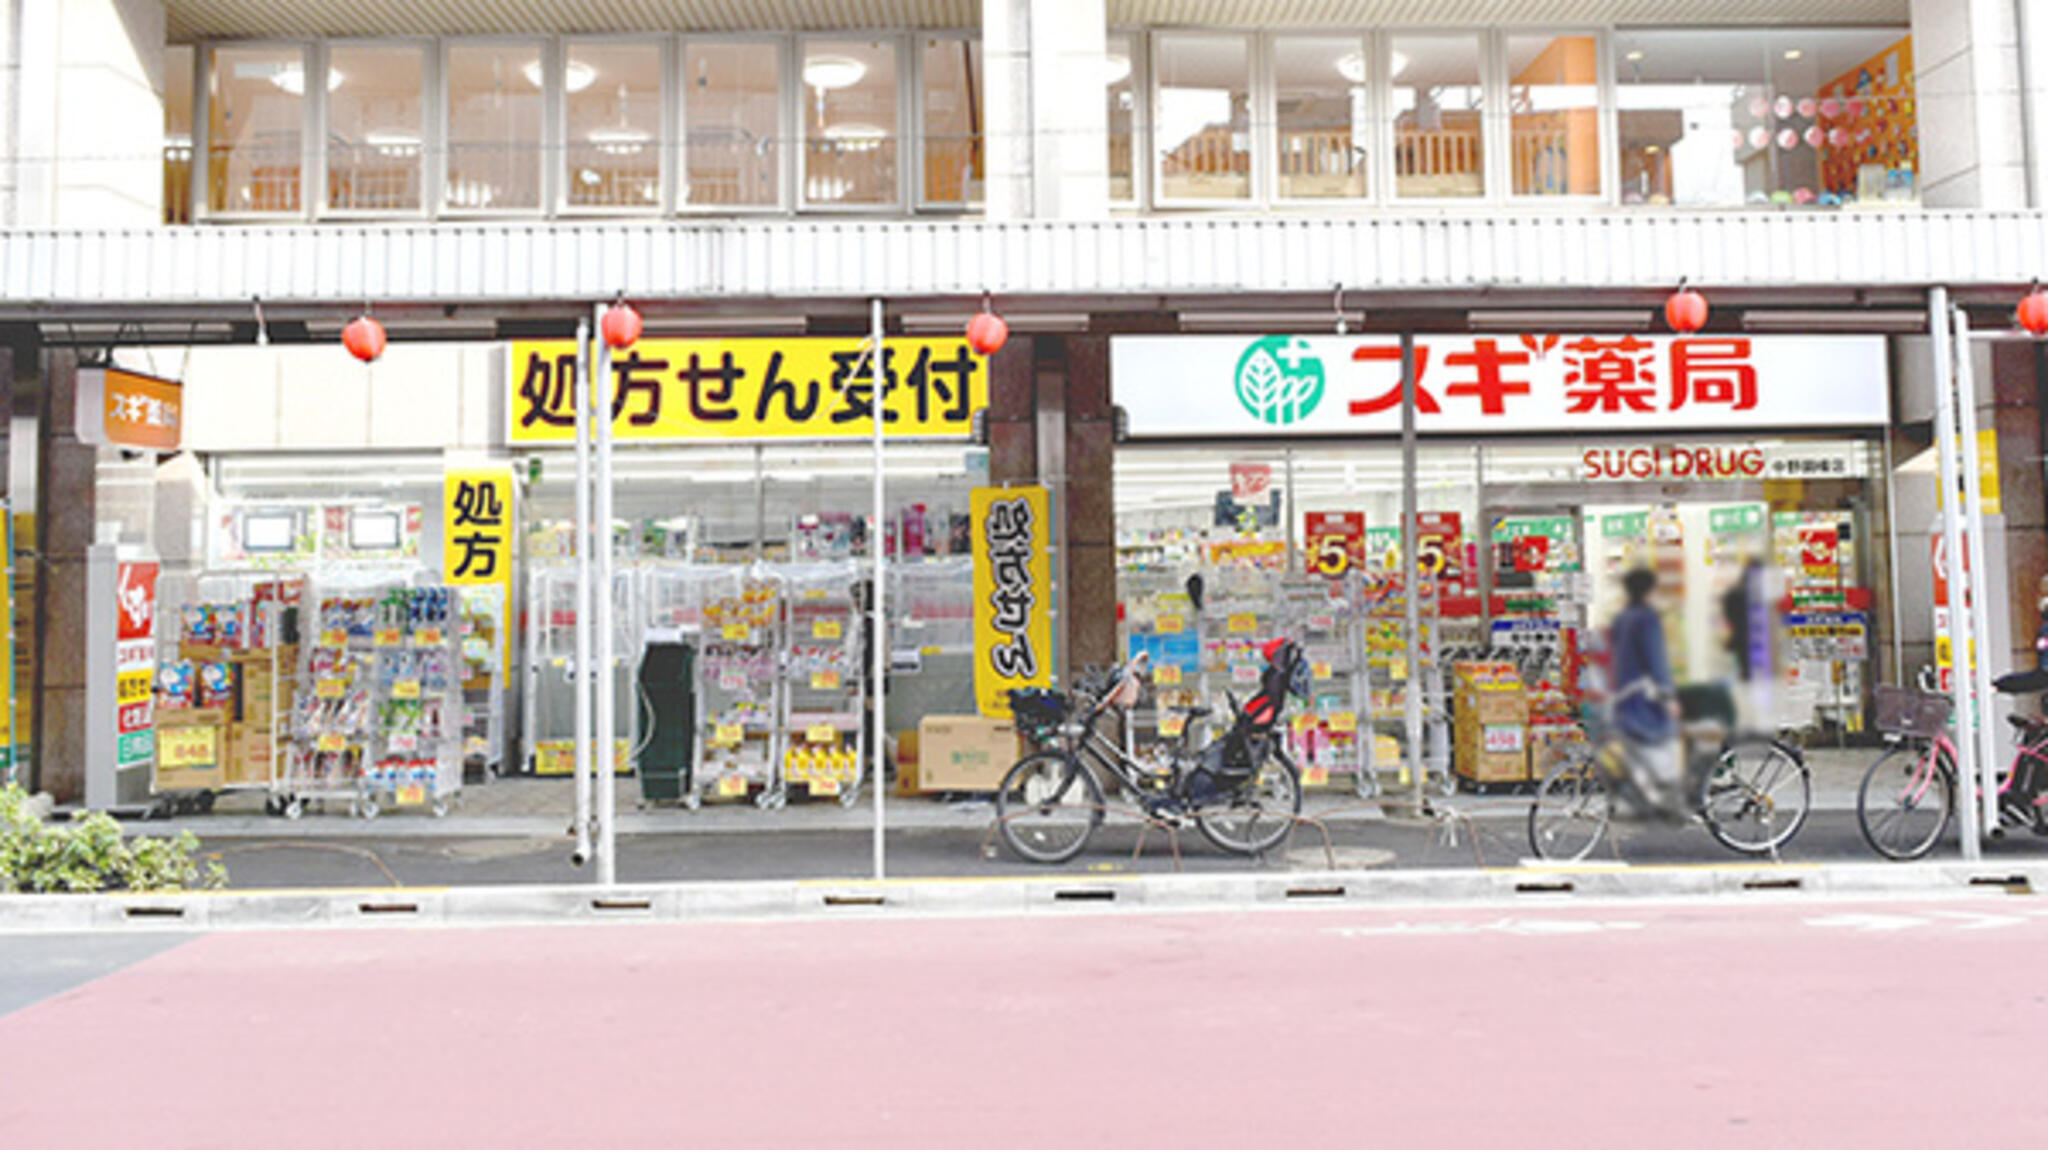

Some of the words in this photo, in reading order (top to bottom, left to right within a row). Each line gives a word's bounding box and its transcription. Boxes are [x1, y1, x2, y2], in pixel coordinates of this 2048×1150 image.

[519, 348, 978, 427] 処方せん受付
[1348, 334, 1758, 415] スギ薬局
[1583, 448, 1662, 479] SUGI
[1671, 446, 1766, 478] DRUG
[453, 480, 503, 578] 処方
[1317, 533, 1349, 576] 5
